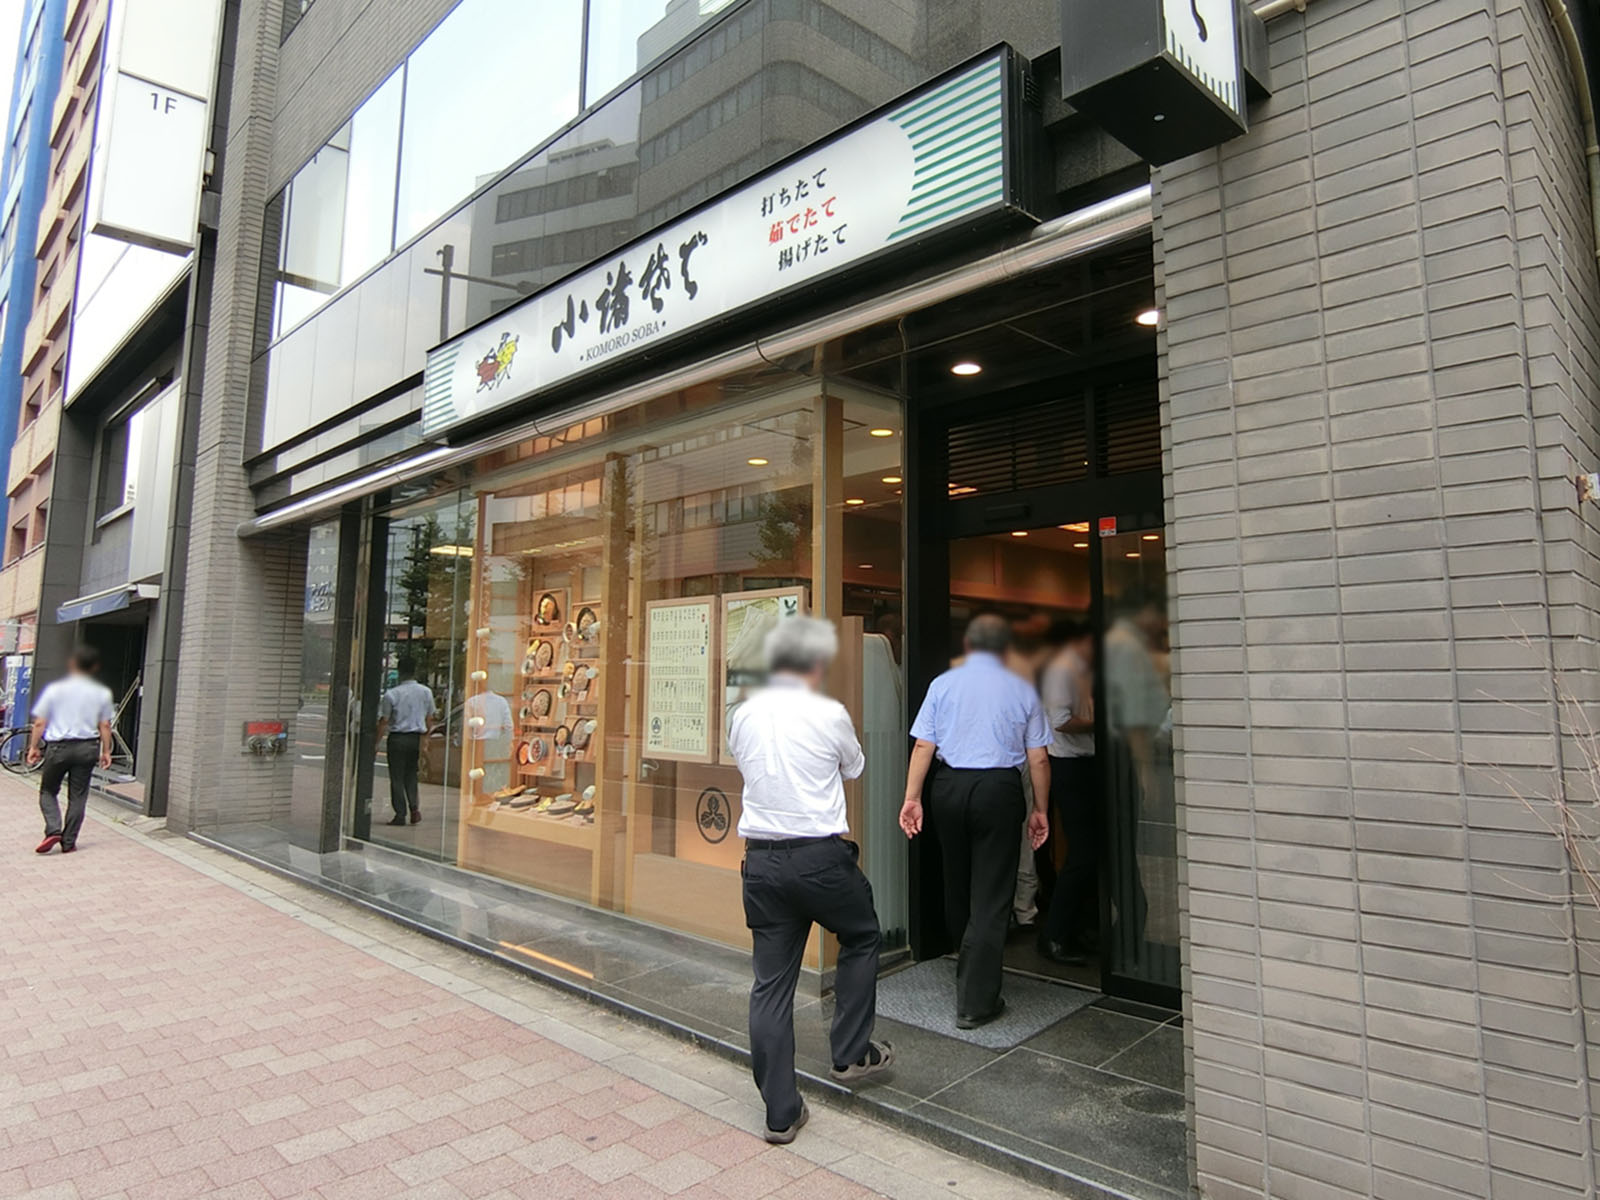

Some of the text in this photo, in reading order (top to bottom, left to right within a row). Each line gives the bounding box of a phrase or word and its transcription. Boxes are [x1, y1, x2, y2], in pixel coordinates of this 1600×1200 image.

[151, 93, 177, 114] 1F
[761, 167, 827, 217] 打ちたて
[769, 196, 837, 244] 茹でたて
[778, 223, 848, 271] 揚げたて
[585, 320, 660, 361] KOMORO SOBA
